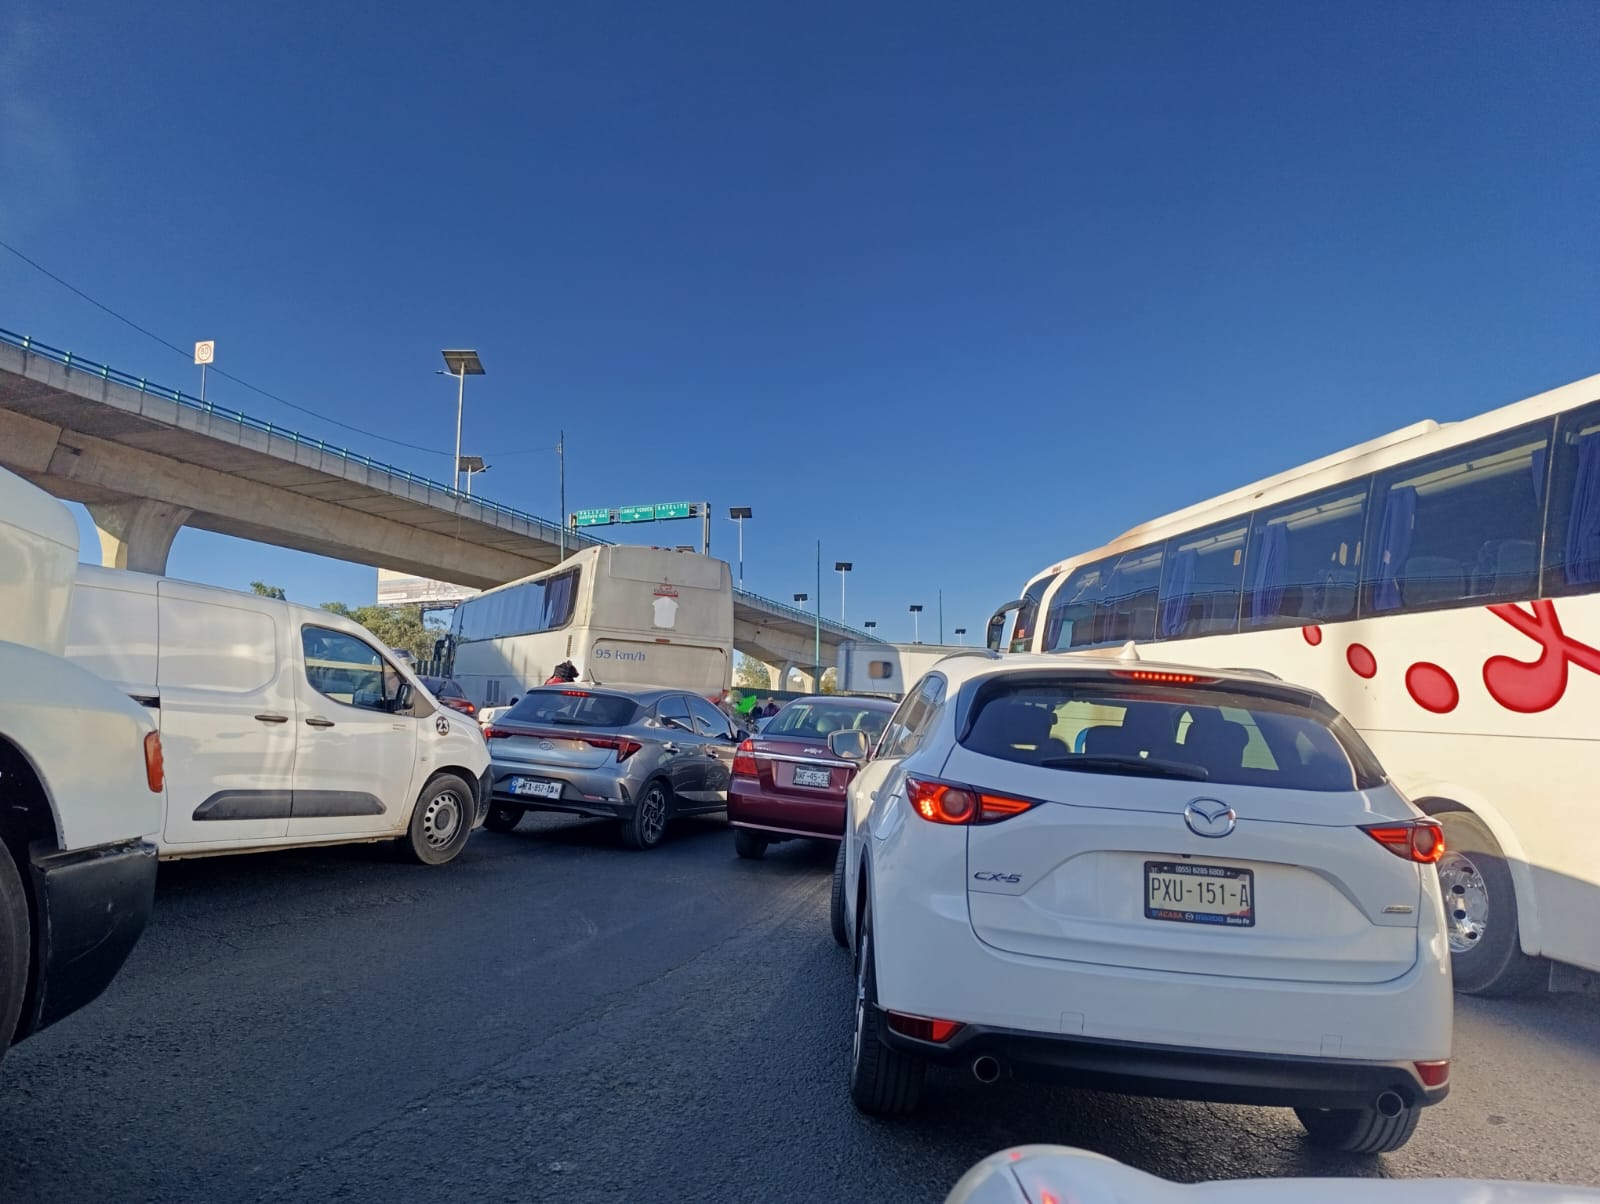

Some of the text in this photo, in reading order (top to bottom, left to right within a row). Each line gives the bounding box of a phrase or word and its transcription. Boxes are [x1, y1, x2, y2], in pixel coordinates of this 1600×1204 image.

[657, 503, 687, 511] SATELITE
[595, 649, 645, 661] 95 km/h
[437, 719, 449, 733] 23
[974, 871, 1022, 883] CX-5
[1151, 877, 1249, 907] PXU-151-A
[1226, 916, 1242, 924] Santa
[1243, 917, 1250, 925] Fe
